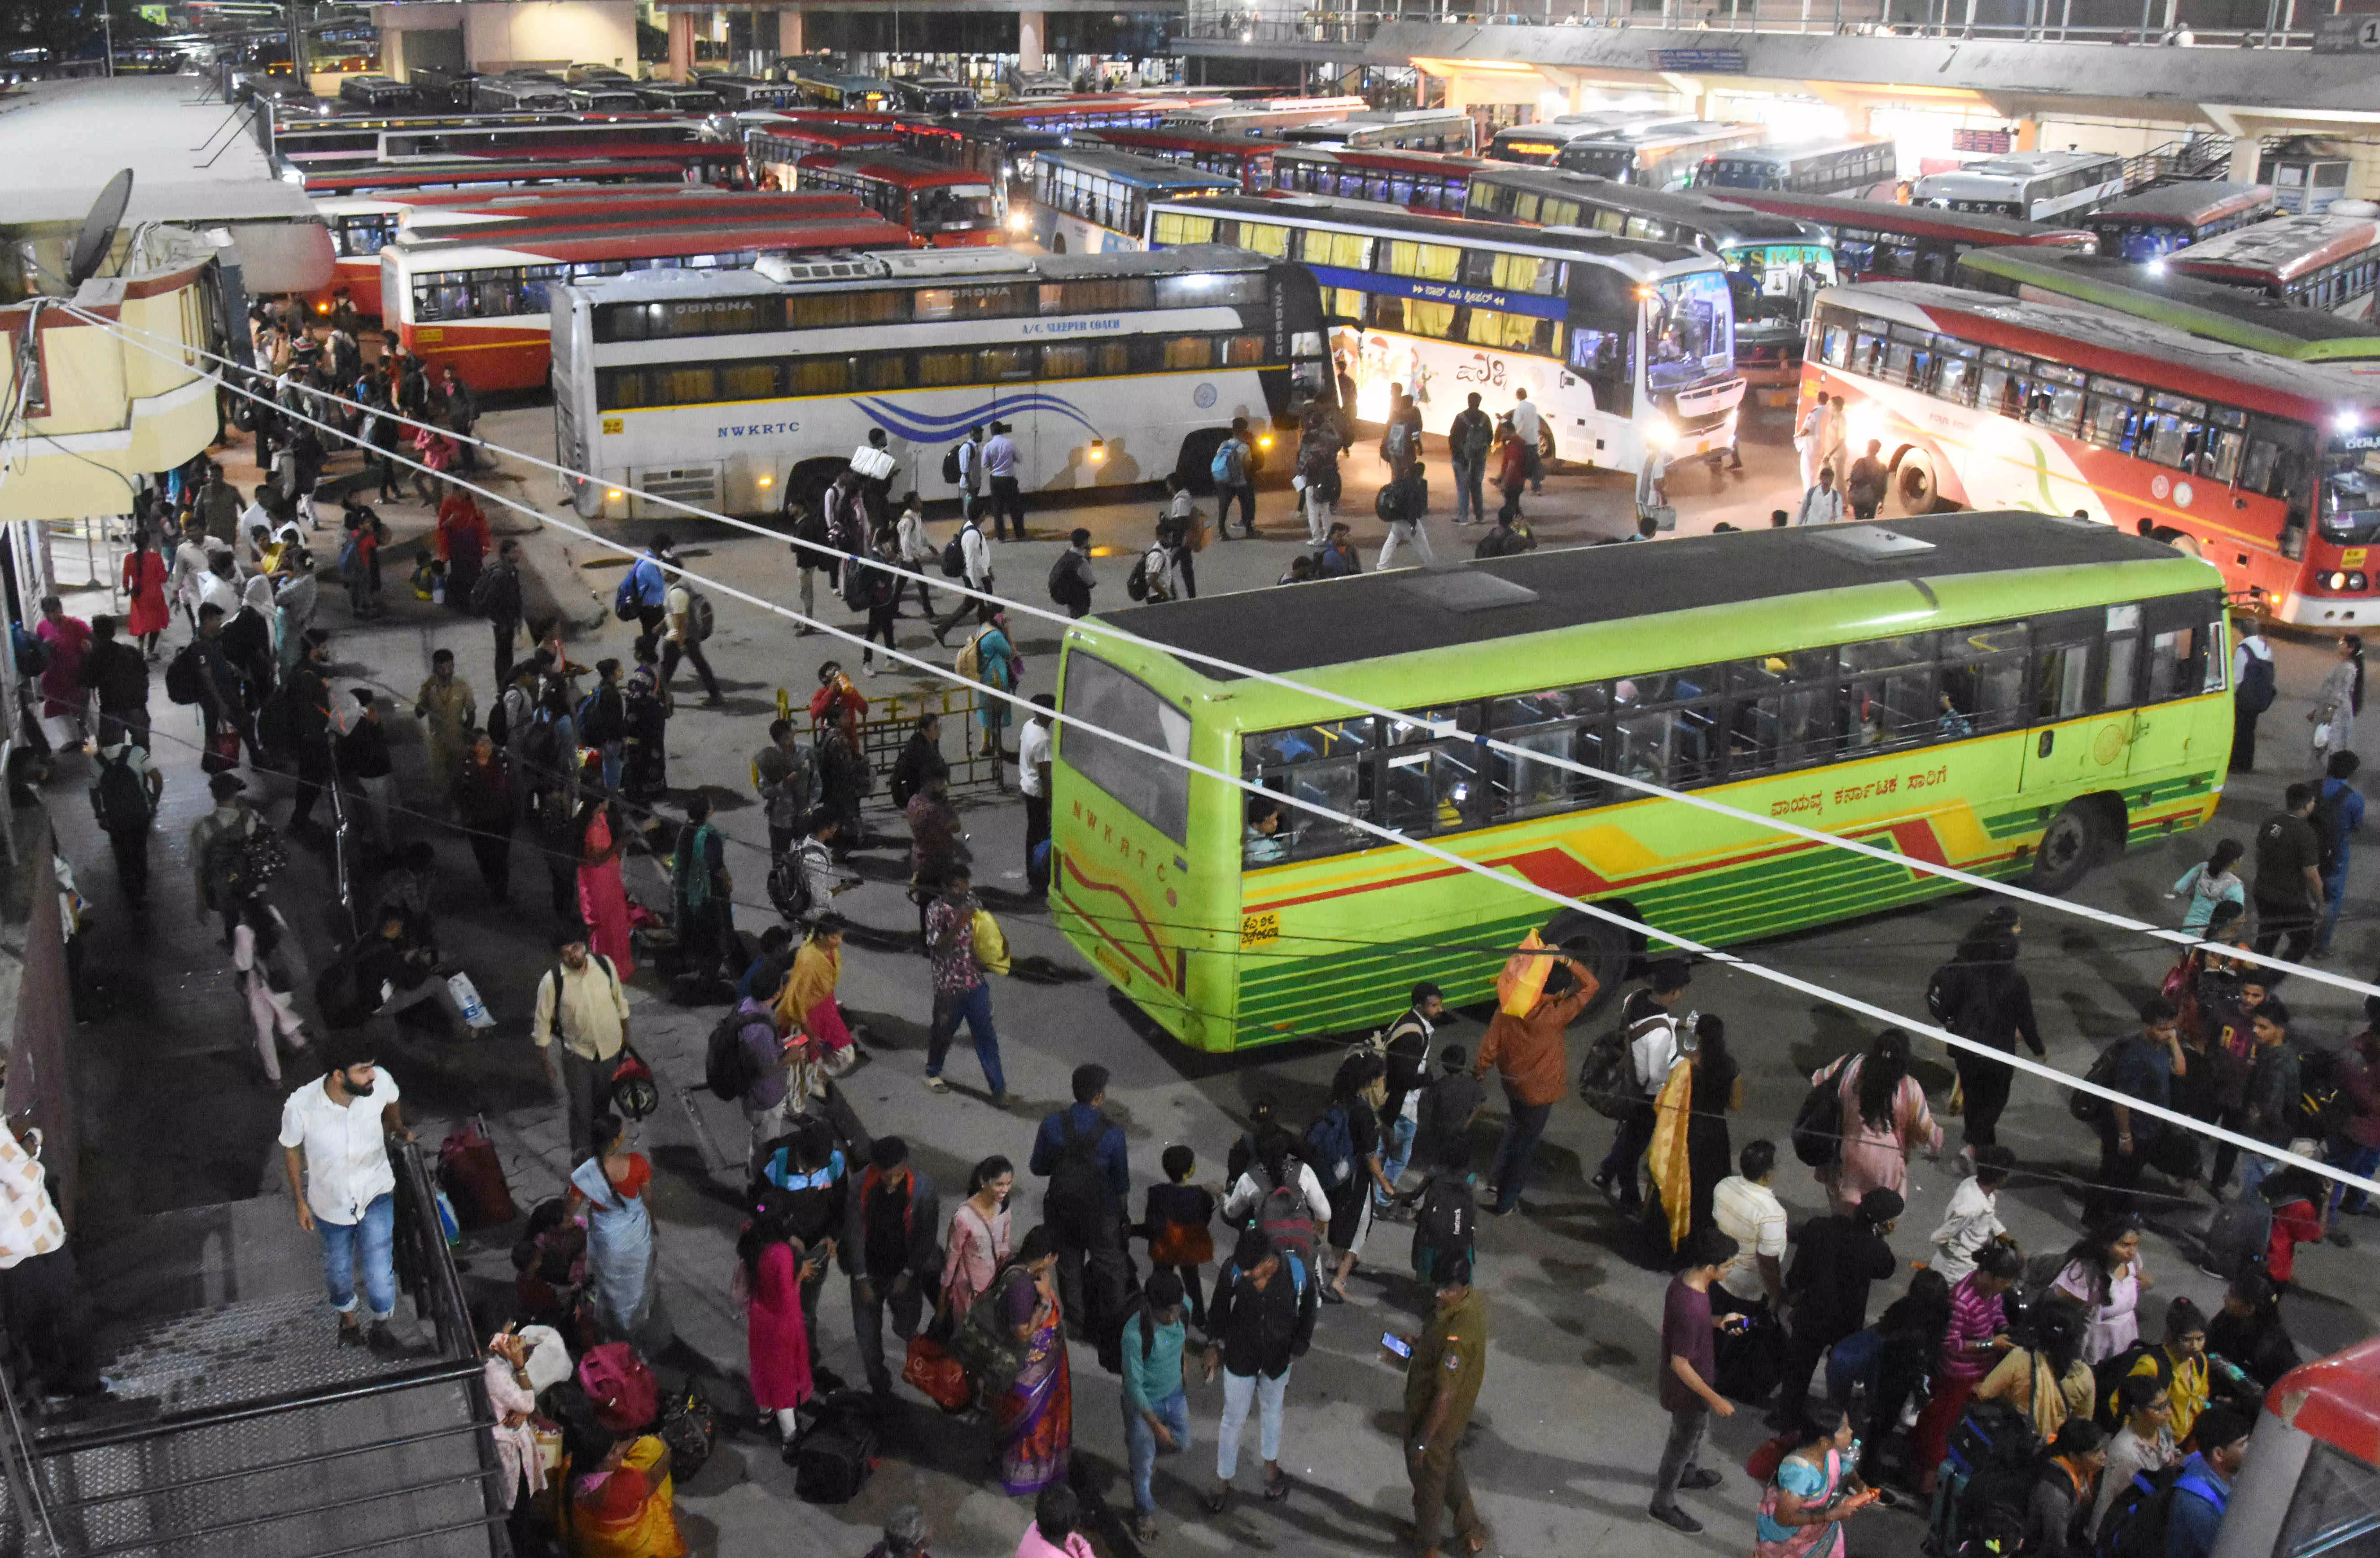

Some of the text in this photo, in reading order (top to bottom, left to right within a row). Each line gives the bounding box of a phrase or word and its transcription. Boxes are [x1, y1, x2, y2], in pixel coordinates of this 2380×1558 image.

[1090, 319, 1120, 331] COACH
[718, 422, 799, 438] NWKRTC
[1834, 775, 1898, 804] ಕರ್ನಾಟಕ
[1907, 765, 1947, 790] ಸಾರಿಗೆ
[1073, 800, 1165, 882] NWKRTC
